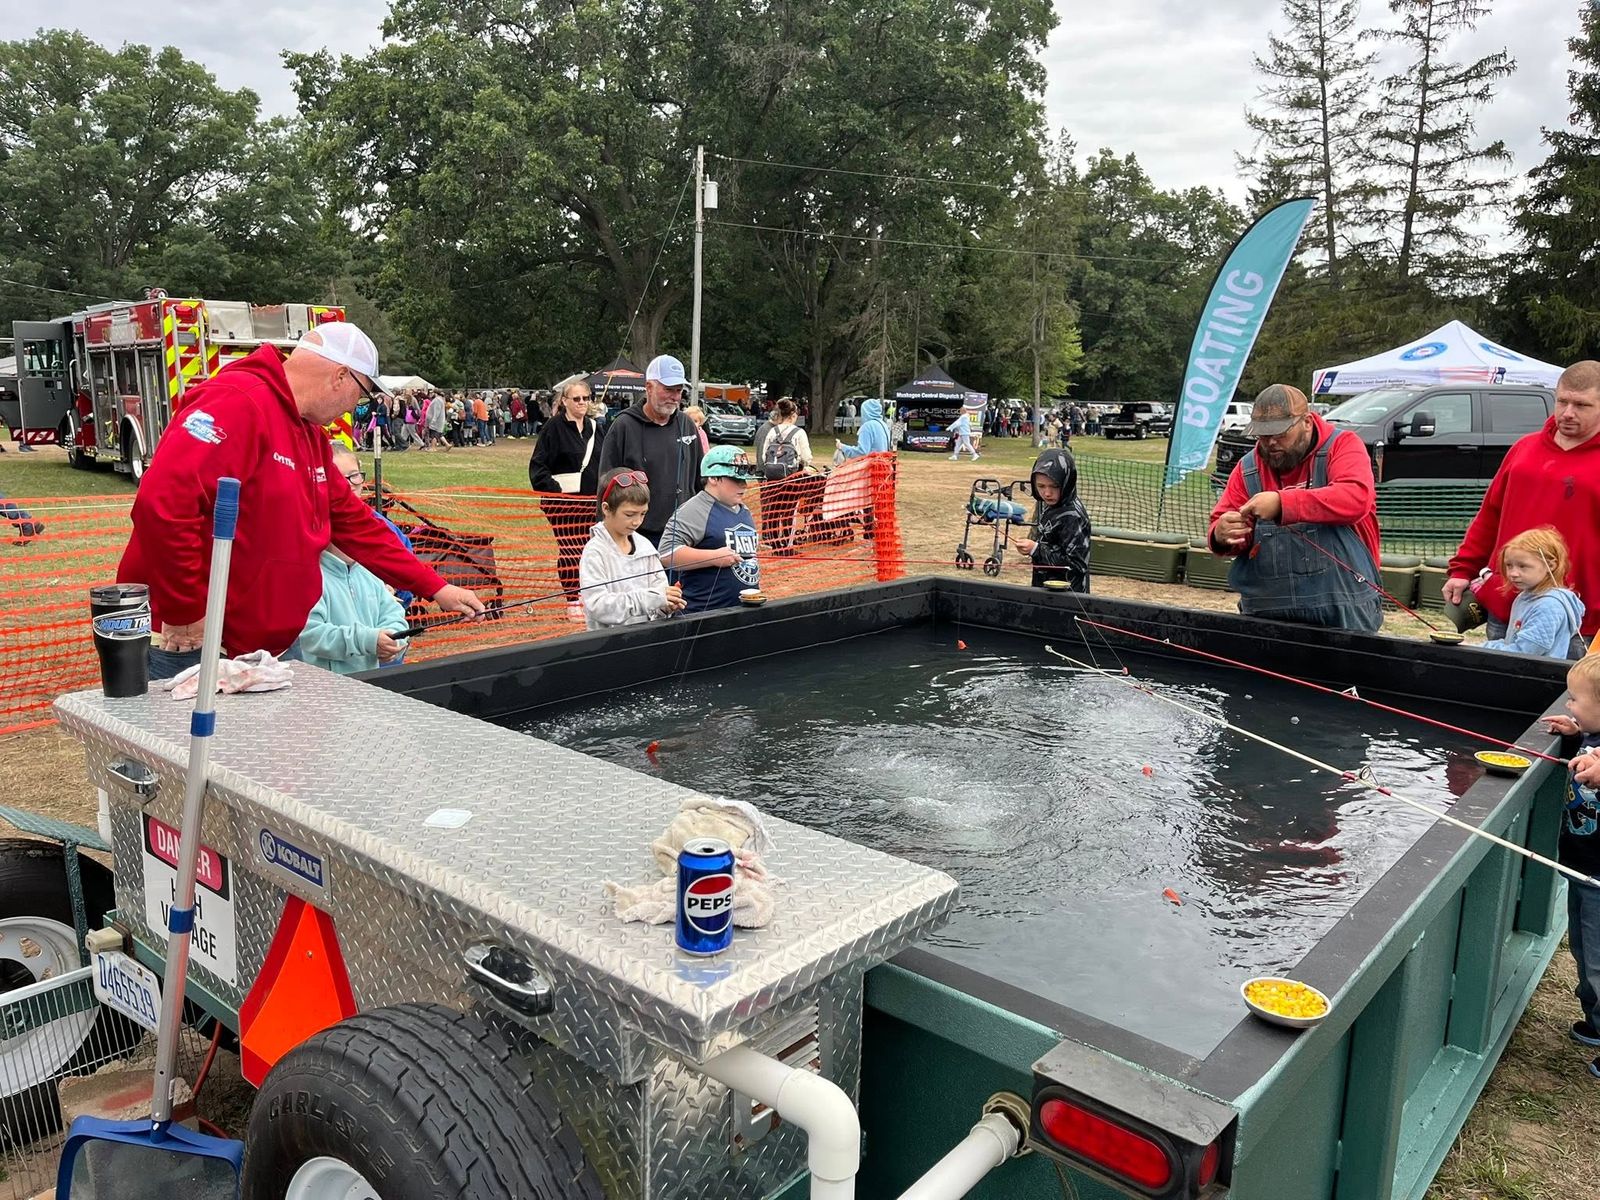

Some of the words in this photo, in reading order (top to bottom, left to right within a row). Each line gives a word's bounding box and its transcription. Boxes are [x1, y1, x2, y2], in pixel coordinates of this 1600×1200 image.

[1182, 269, 1264, 429] BOATING
[156, 825, 211, 879] DANR
[277, 843, 320, 880] KOBALT
[160, 900, 217, 960] VAGE
[98, 955, 156, 1023] D465539
[269, 1090, 396, 1180] CARLISLE
